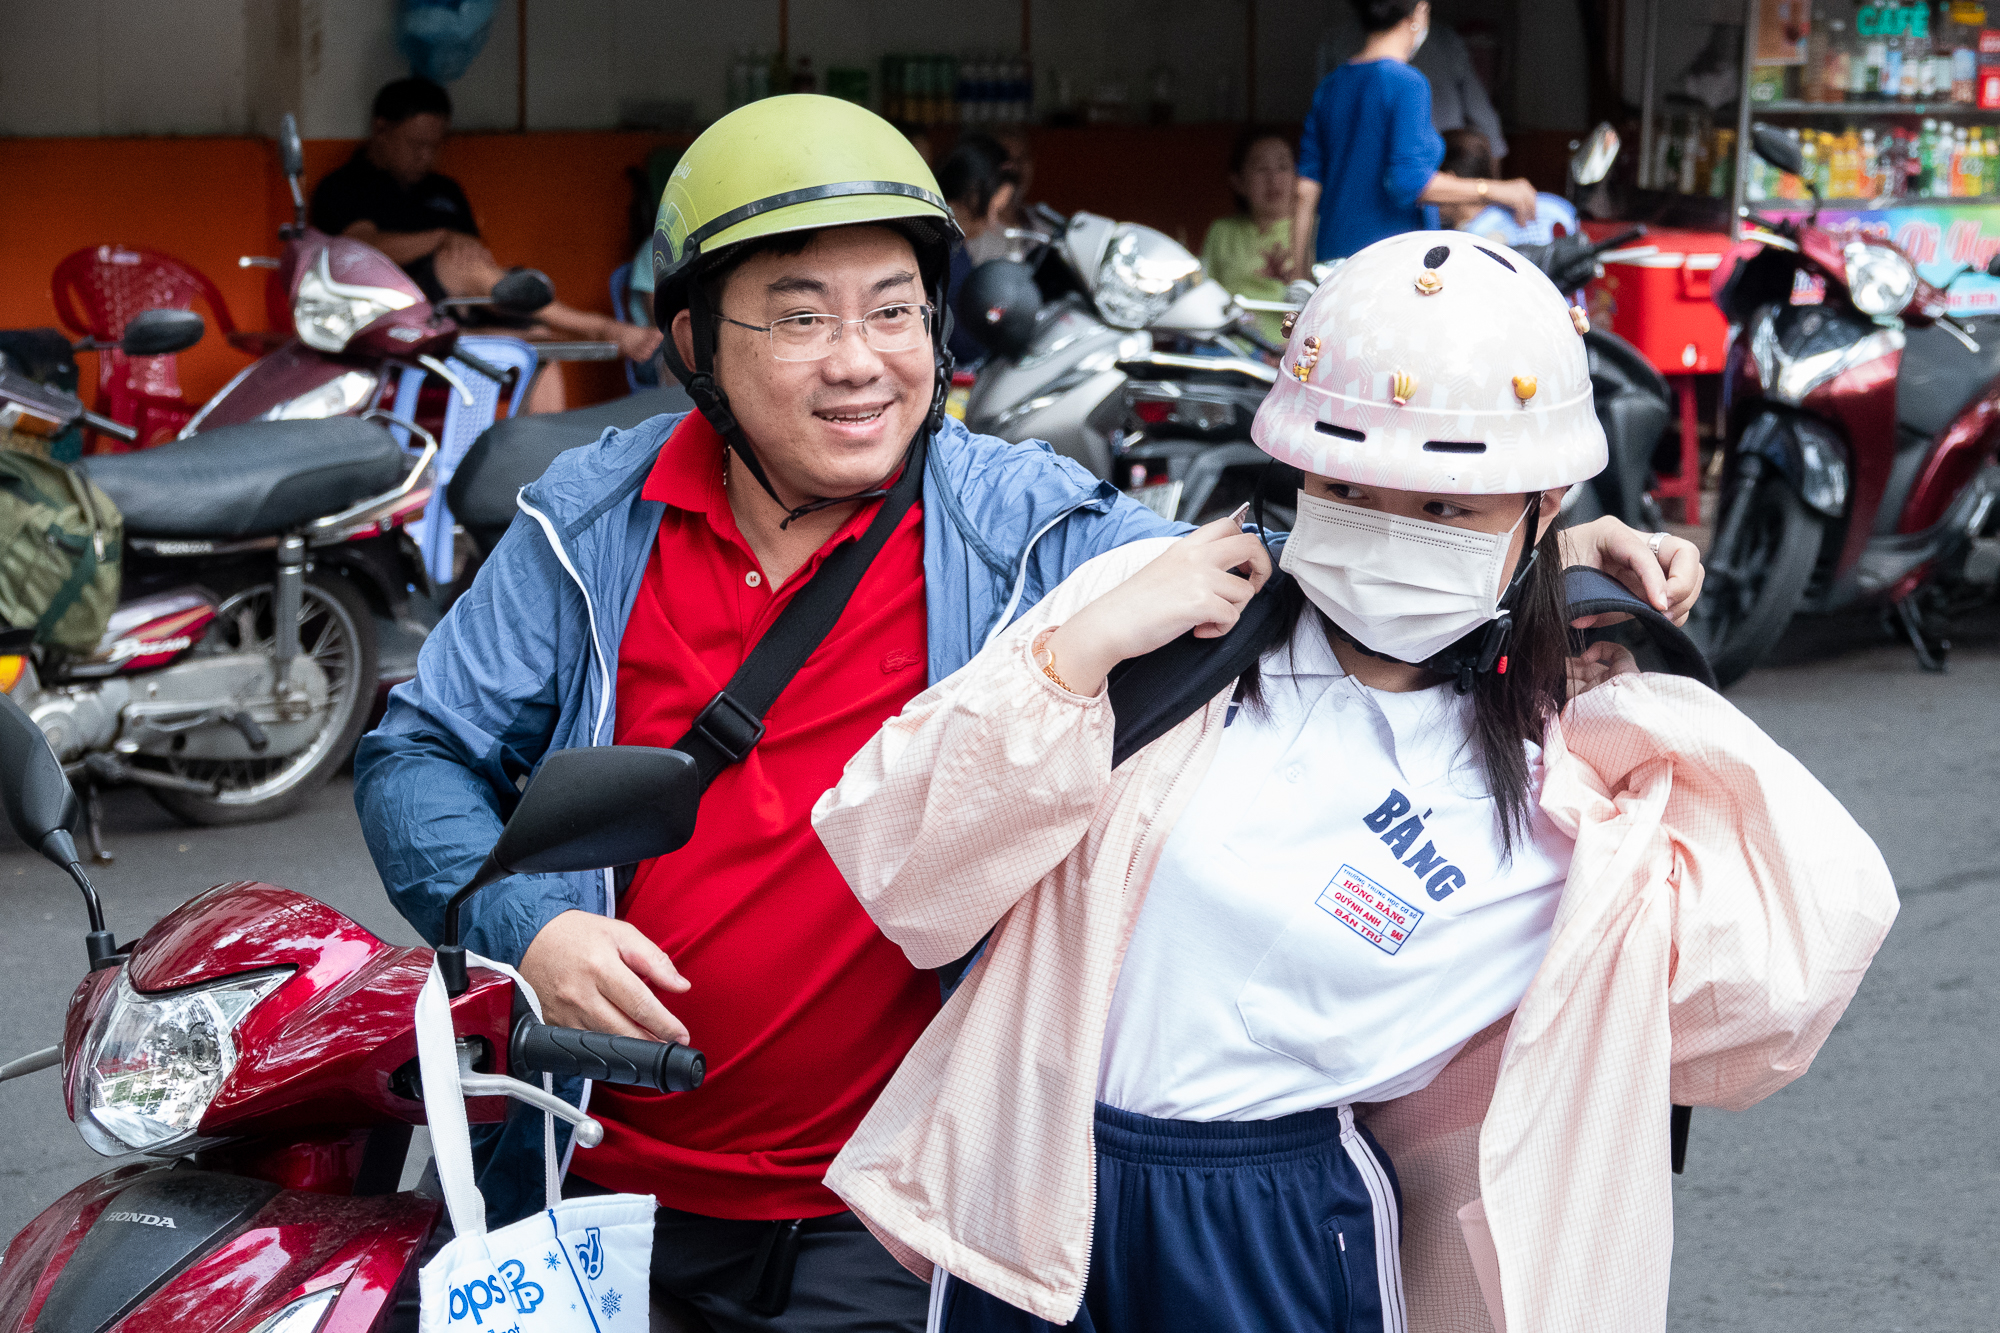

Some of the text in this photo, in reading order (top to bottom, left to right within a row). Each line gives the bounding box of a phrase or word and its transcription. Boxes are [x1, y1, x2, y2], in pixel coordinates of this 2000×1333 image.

[1367, 883, 1386, 899] TRUNG
[1334, 908, 1382, 943] BÁN TRÚ
[1363, 911, 1382, 927] ANH
[105, 1211, 177, 1229] HONDA
